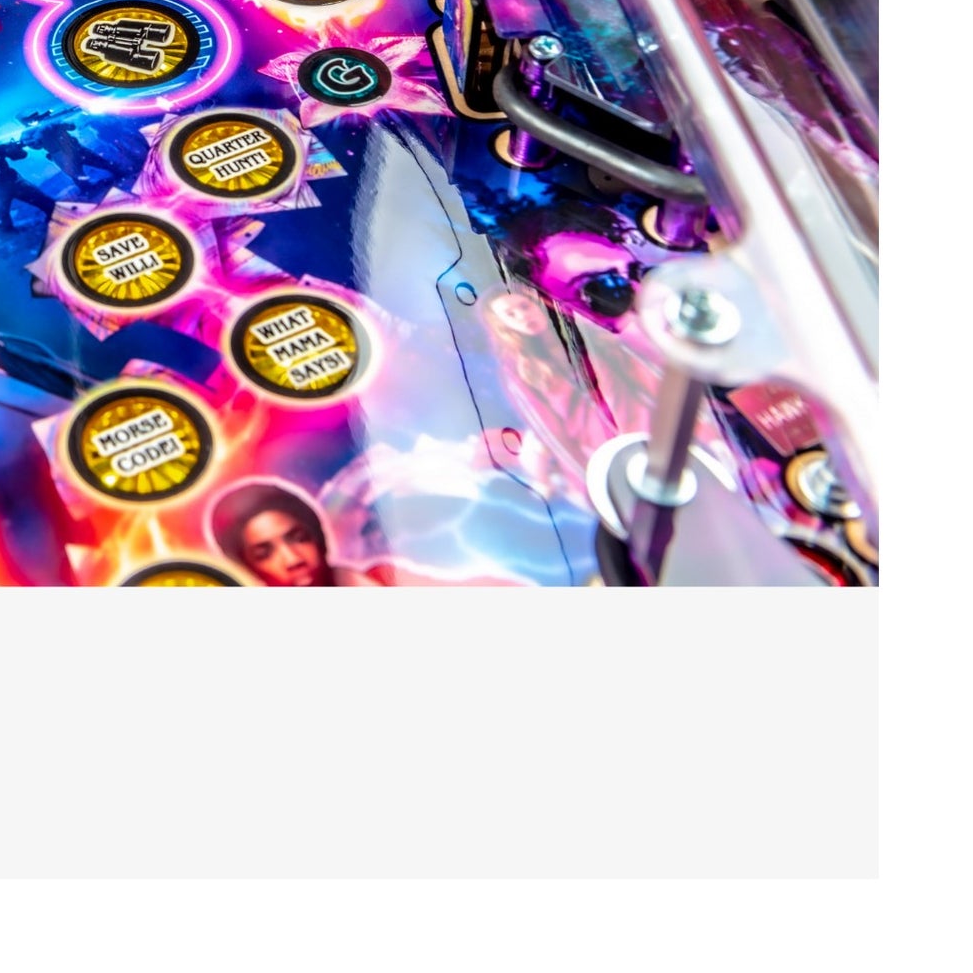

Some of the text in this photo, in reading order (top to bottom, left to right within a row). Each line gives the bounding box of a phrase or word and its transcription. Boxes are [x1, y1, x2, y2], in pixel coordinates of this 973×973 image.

[316, 58, 375, 95] G
[188, 129, 268, 166] QUARTER
[214, 151, 267, 180] HUNT!
[96, 235, 145, 262] SAVE
[108, 256, 160, 282] WILL!
[256, 308, 312, 340] WHAT
[271, 332, 330, 362] MAMA
[290, 353, 347, 384] SAYS!
[97, 411, 169, 452] MORSE
[116, 437, 180, 473] CODE!
